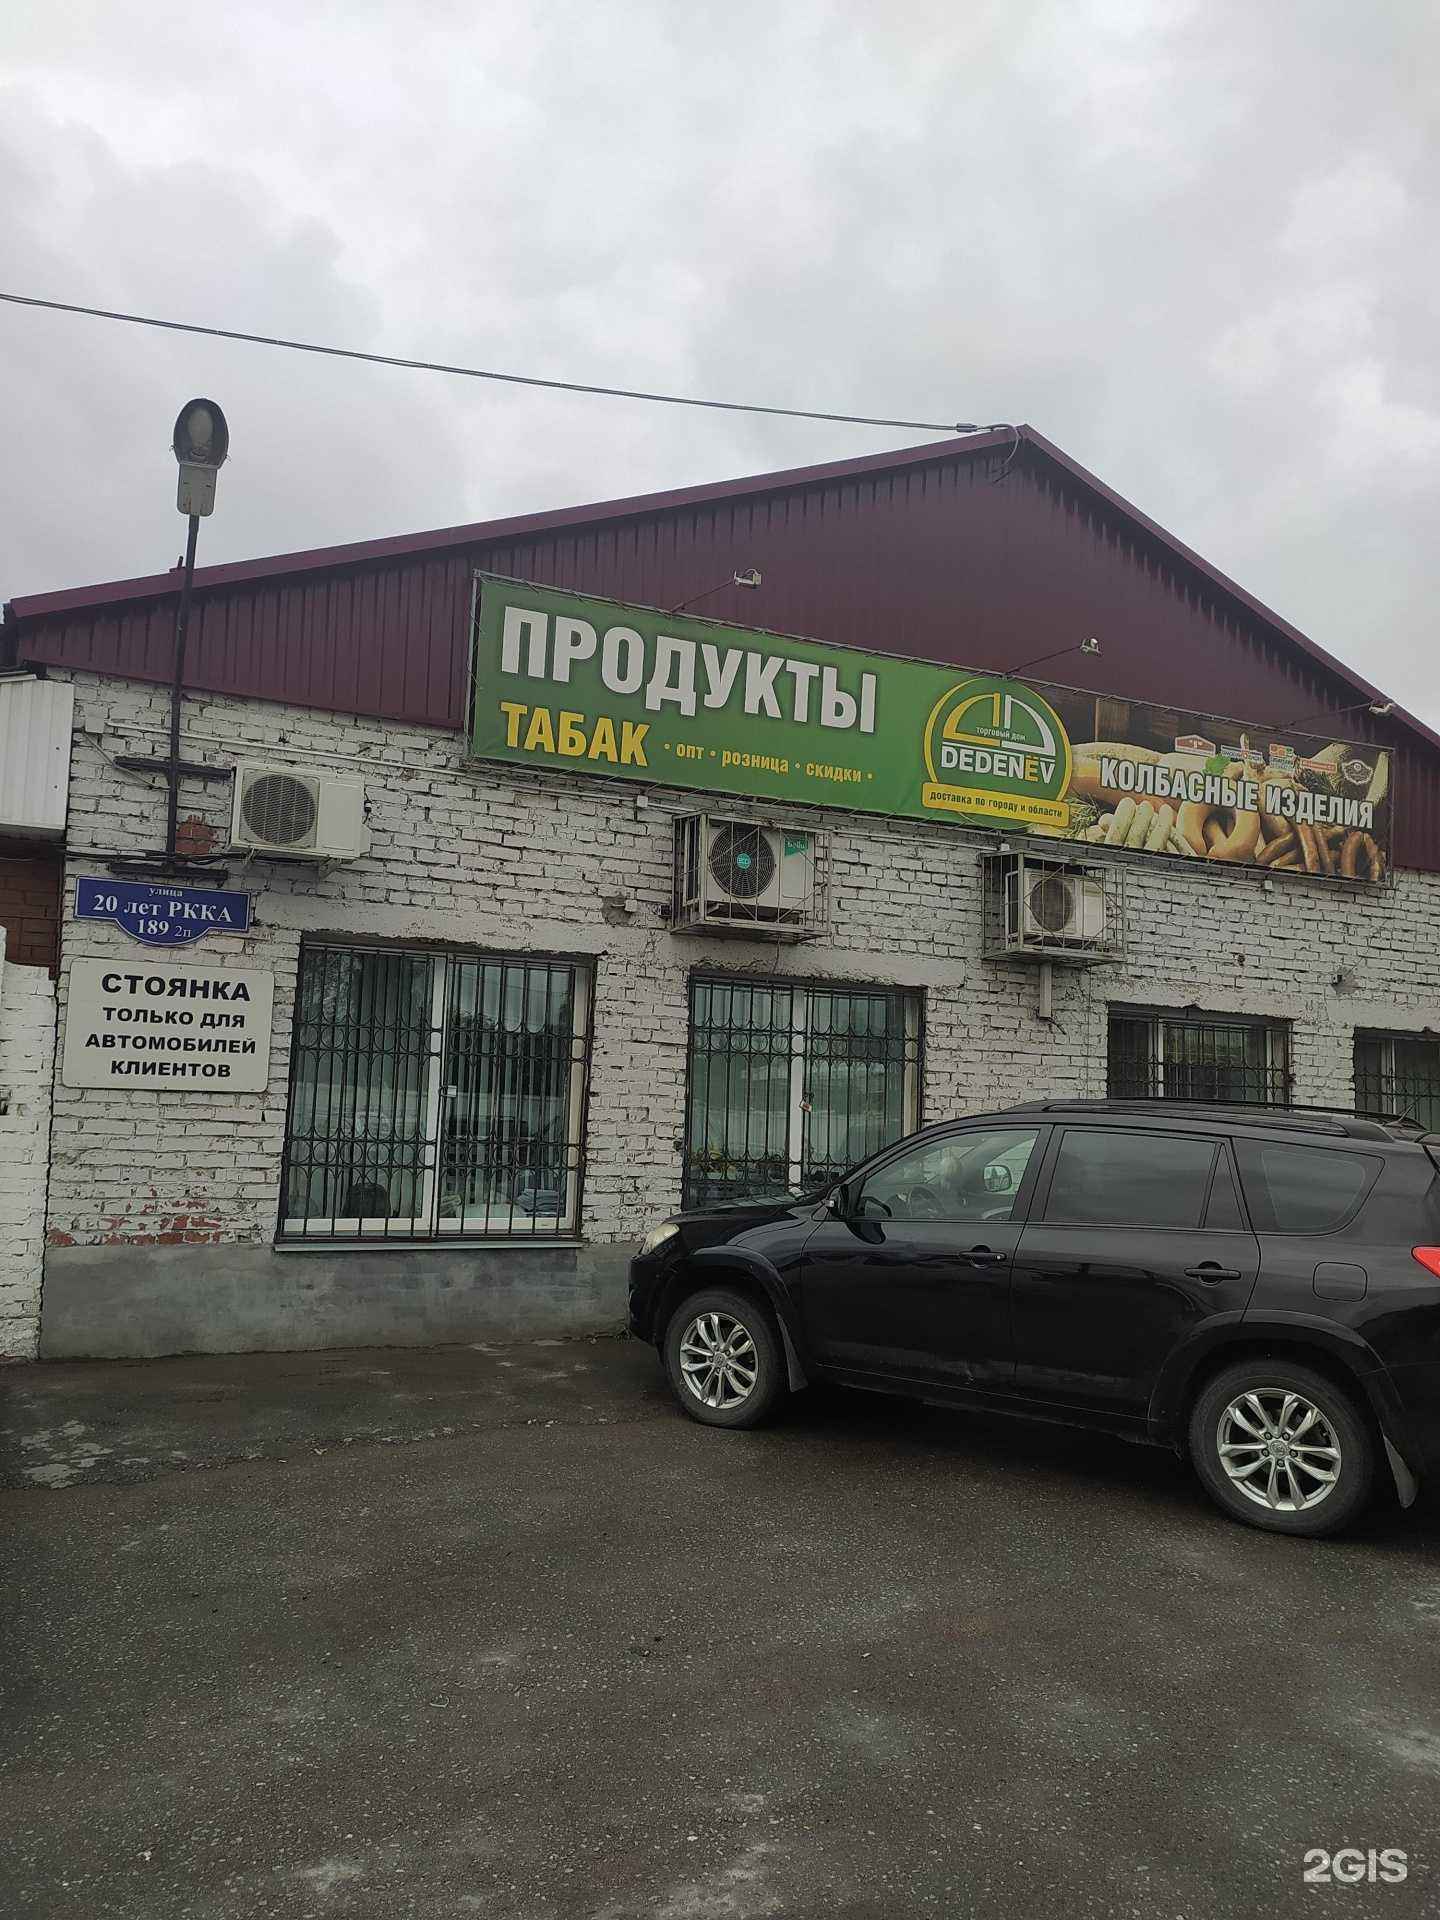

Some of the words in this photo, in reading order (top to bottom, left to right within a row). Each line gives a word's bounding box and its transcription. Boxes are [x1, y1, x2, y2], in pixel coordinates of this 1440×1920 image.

[501, 605, 877, 733] ПРОДУКТЫ
[501, 702, 651, 767] ТАБАК
[676, 742, 704, 760] опт
[722, 749, 789, 774] розница
[806, 761, 862, 783] скидки
[930, 791, 972, 805] доставка
[975, 797, 986, 806] по
[988, 799, 1018, 812] городу
[1028, 803, 1062, 817] области
[1101, 756, 1259, 811] КОЛБАСНЫЕ
[1266, 784, 1373, 829] ИЗДЕЛИЯ
[149, 887, 183, 898] улица
[92, 894, 118, 912] 20
[124, 901, 162, 916] лет
[168, 901, 233, 923] РККА
[136, 919, 169, 935] 189
[175, 925, 192, 938] 2п
[101, 973, 250, 1002] СТОЯНКА
[102, 1007, 194, 1026] ТОЛЬКО
[200, 1012, 245, 1029] ДЛЯ
[85, 1033, 256, 1054] АВТОМОБИЛЕЙ
[110, 1060, 231, 1078] КЛИЕНТОВ
